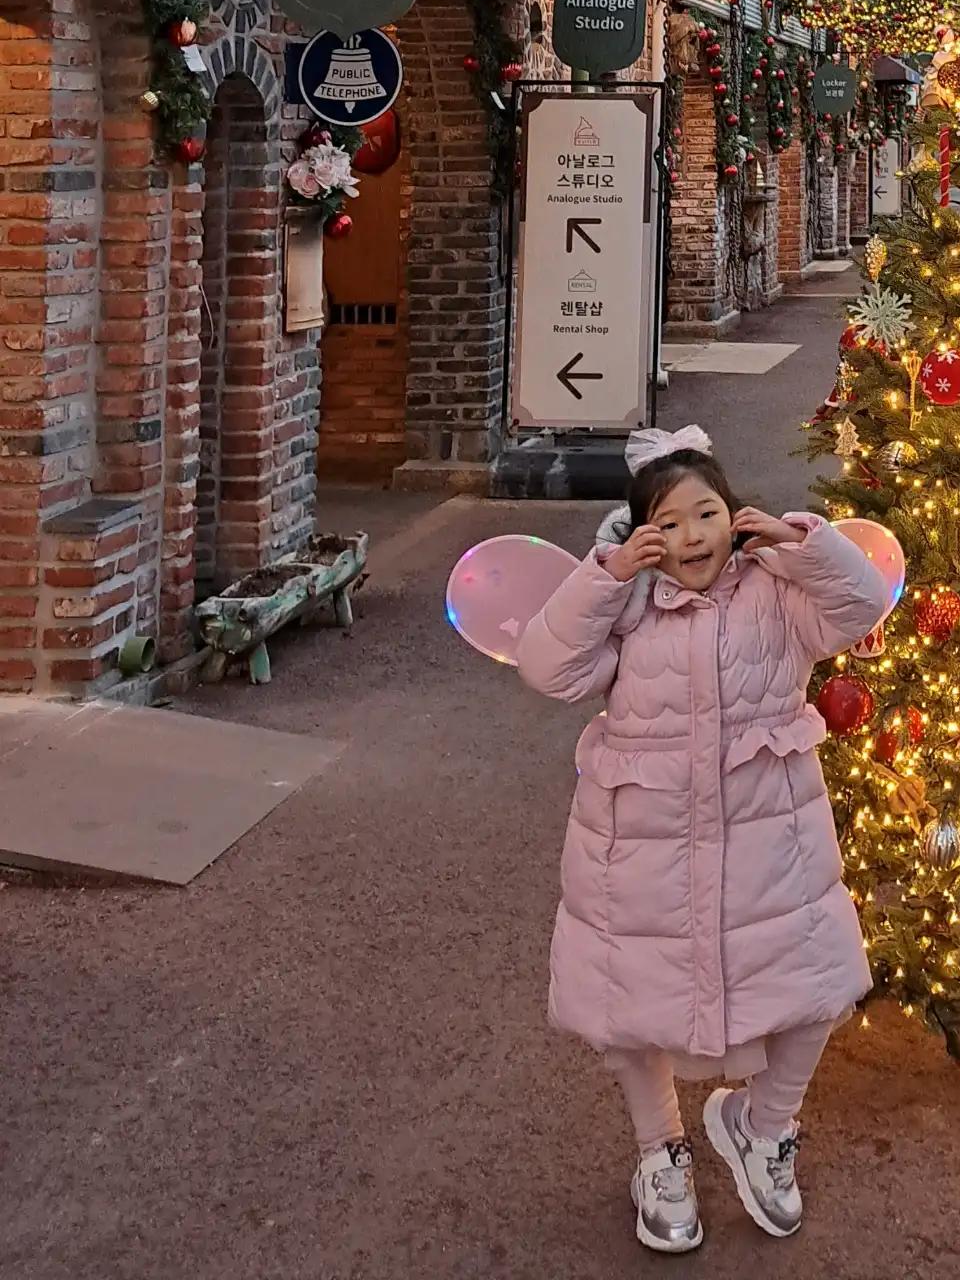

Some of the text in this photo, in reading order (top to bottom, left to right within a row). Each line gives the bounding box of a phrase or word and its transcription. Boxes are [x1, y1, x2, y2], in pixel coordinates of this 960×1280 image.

[575, 15, 624, 30] Studio
[331, 68, 370, 79] PUBLIC
[822, 79, 847, 87] Locker
[320, 85, 382, 98] TELEPHONE
[557, 154, 615, 169] 아날로그
[556, 173, 615, 189] 스튜디오
[547, 194, 623, 205] Analogue Studio
[560, 301, 603, 317] 렌탈샵
[553, 324, 609, 335] Rental Shop
